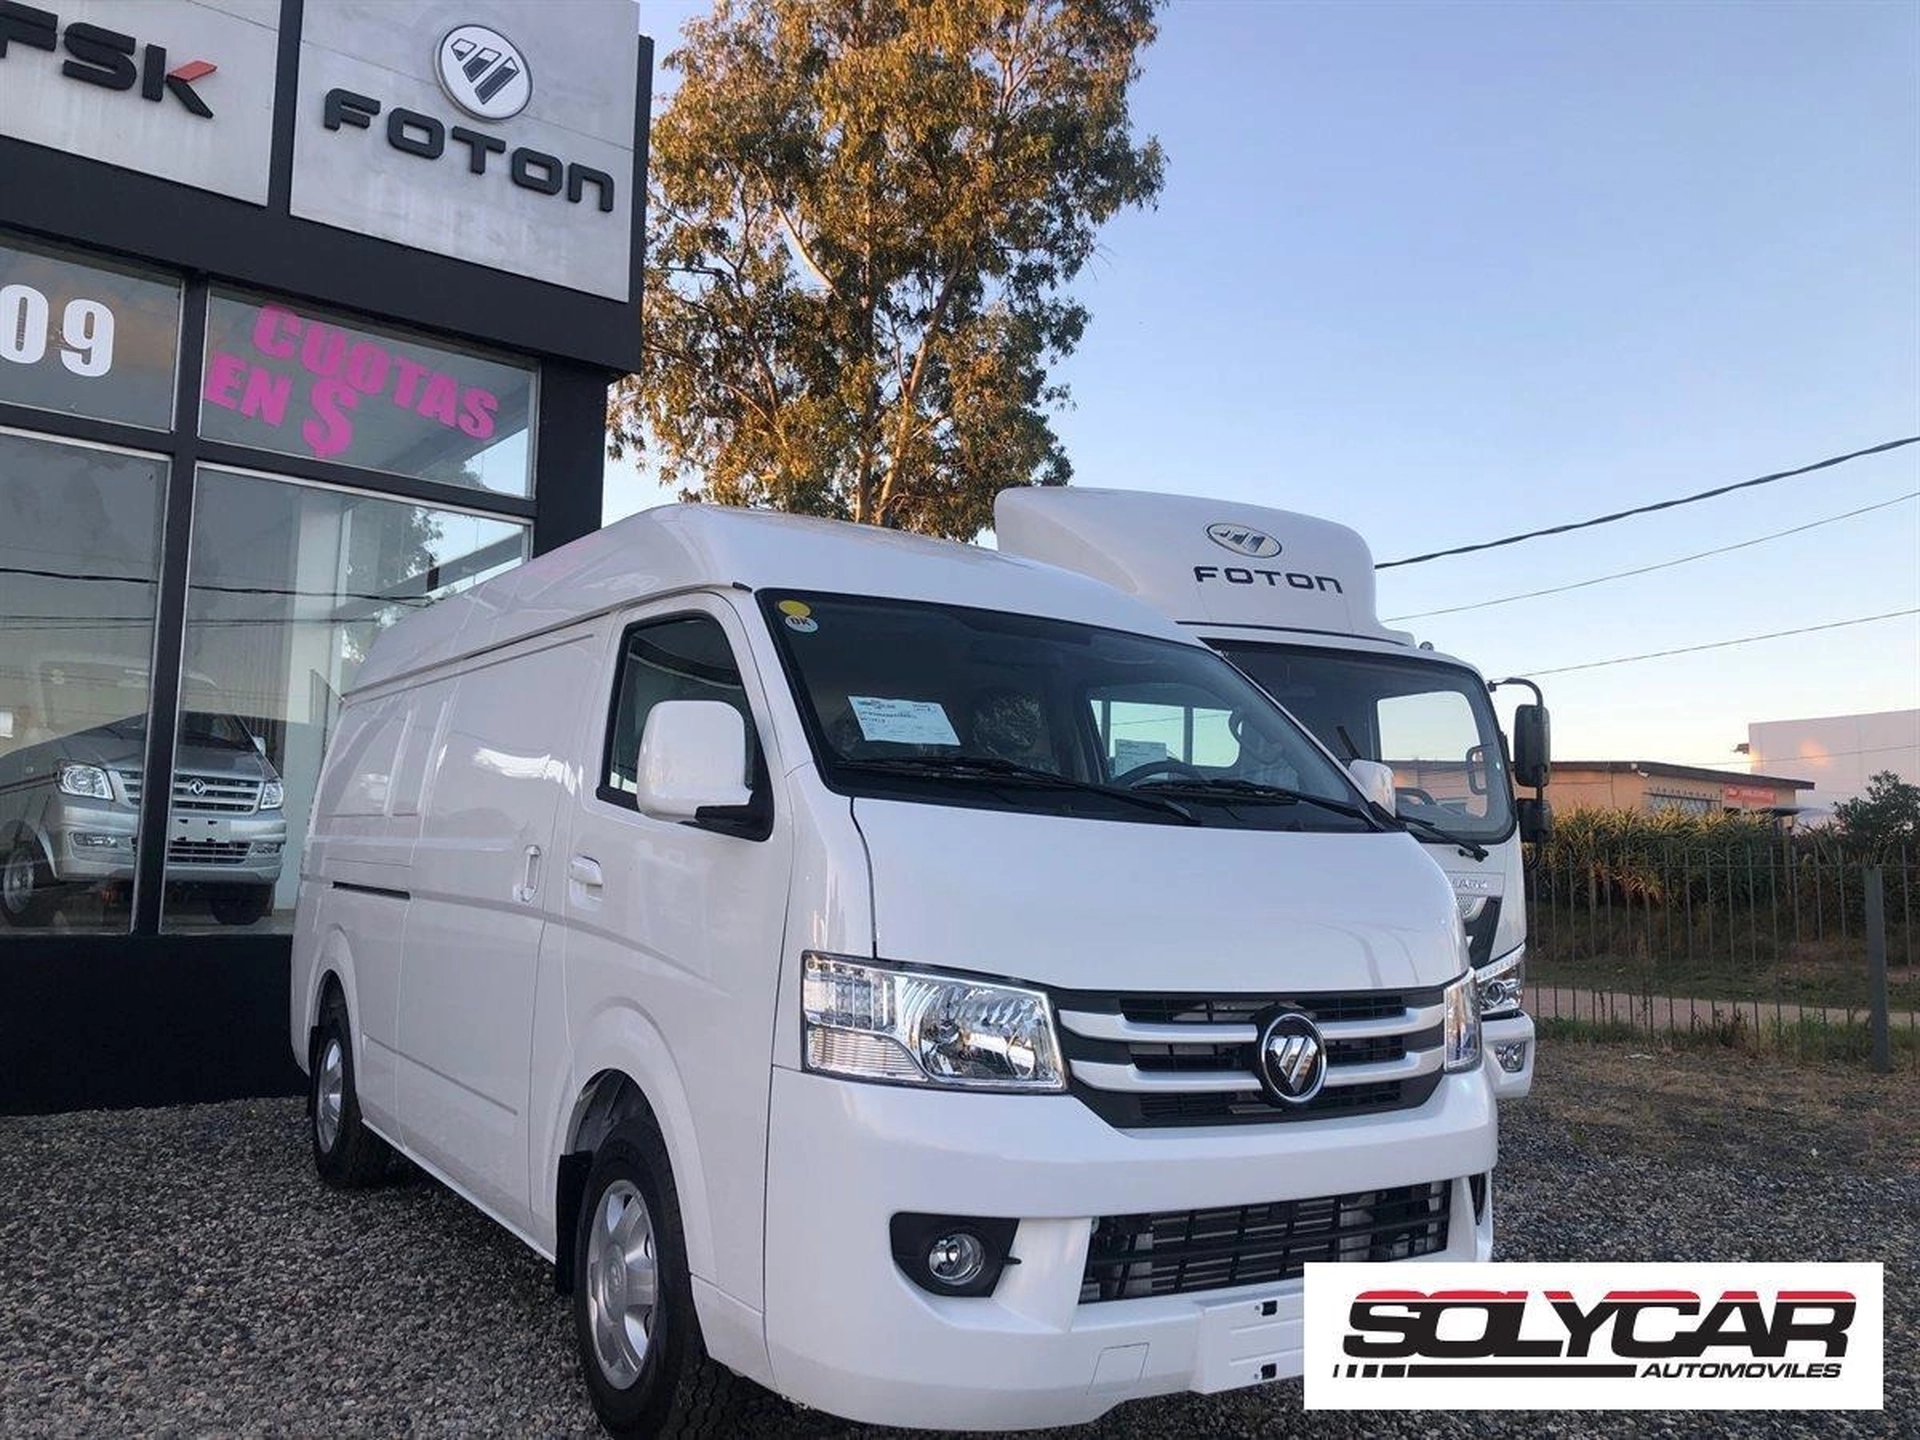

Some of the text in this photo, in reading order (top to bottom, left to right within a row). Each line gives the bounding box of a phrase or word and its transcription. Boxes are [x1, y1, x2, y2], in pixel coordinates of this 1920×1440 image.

[324, 87, 615, 213] FOTON
[0, 284, 114, 377] 09
[252, 303, 499, 440] CUOTAS
[204, 353, 293, 427] EN
[1193, 566, 1343, 594] FOTON
